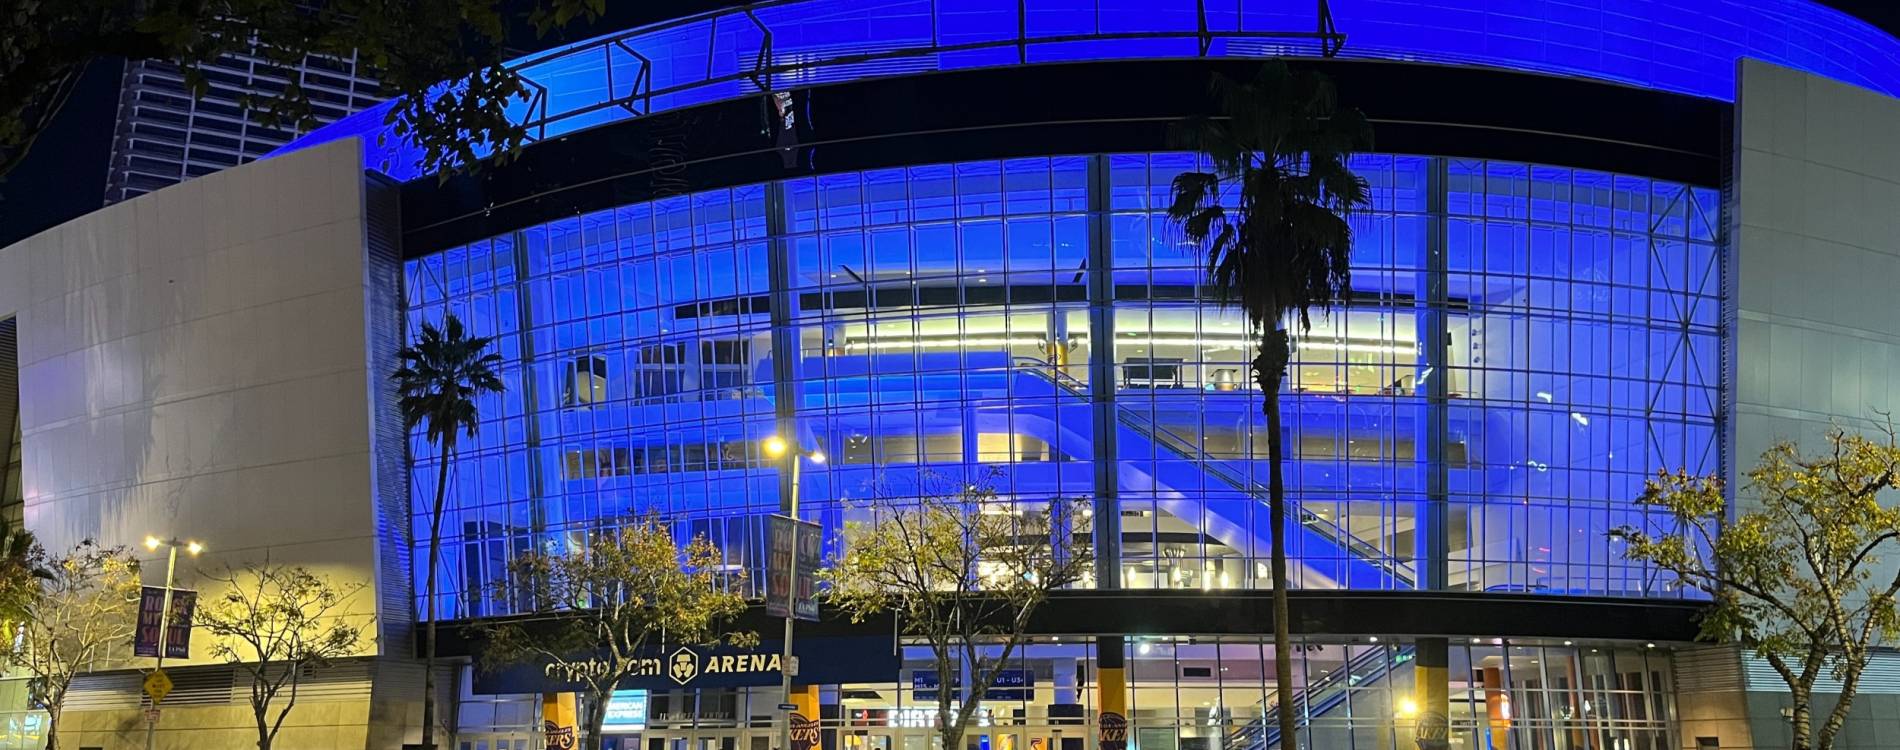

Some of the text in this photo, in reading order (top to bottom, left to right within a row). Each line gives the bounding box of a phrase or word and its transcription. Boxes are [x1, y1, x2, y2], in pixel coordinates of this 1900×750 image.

[704, 653, 782, 673] ARENA
[609, 702, 643, 710] MERICAN
[608, 710, 642, 719] XPRESS
[888, 710, 939, 728] DIRT
